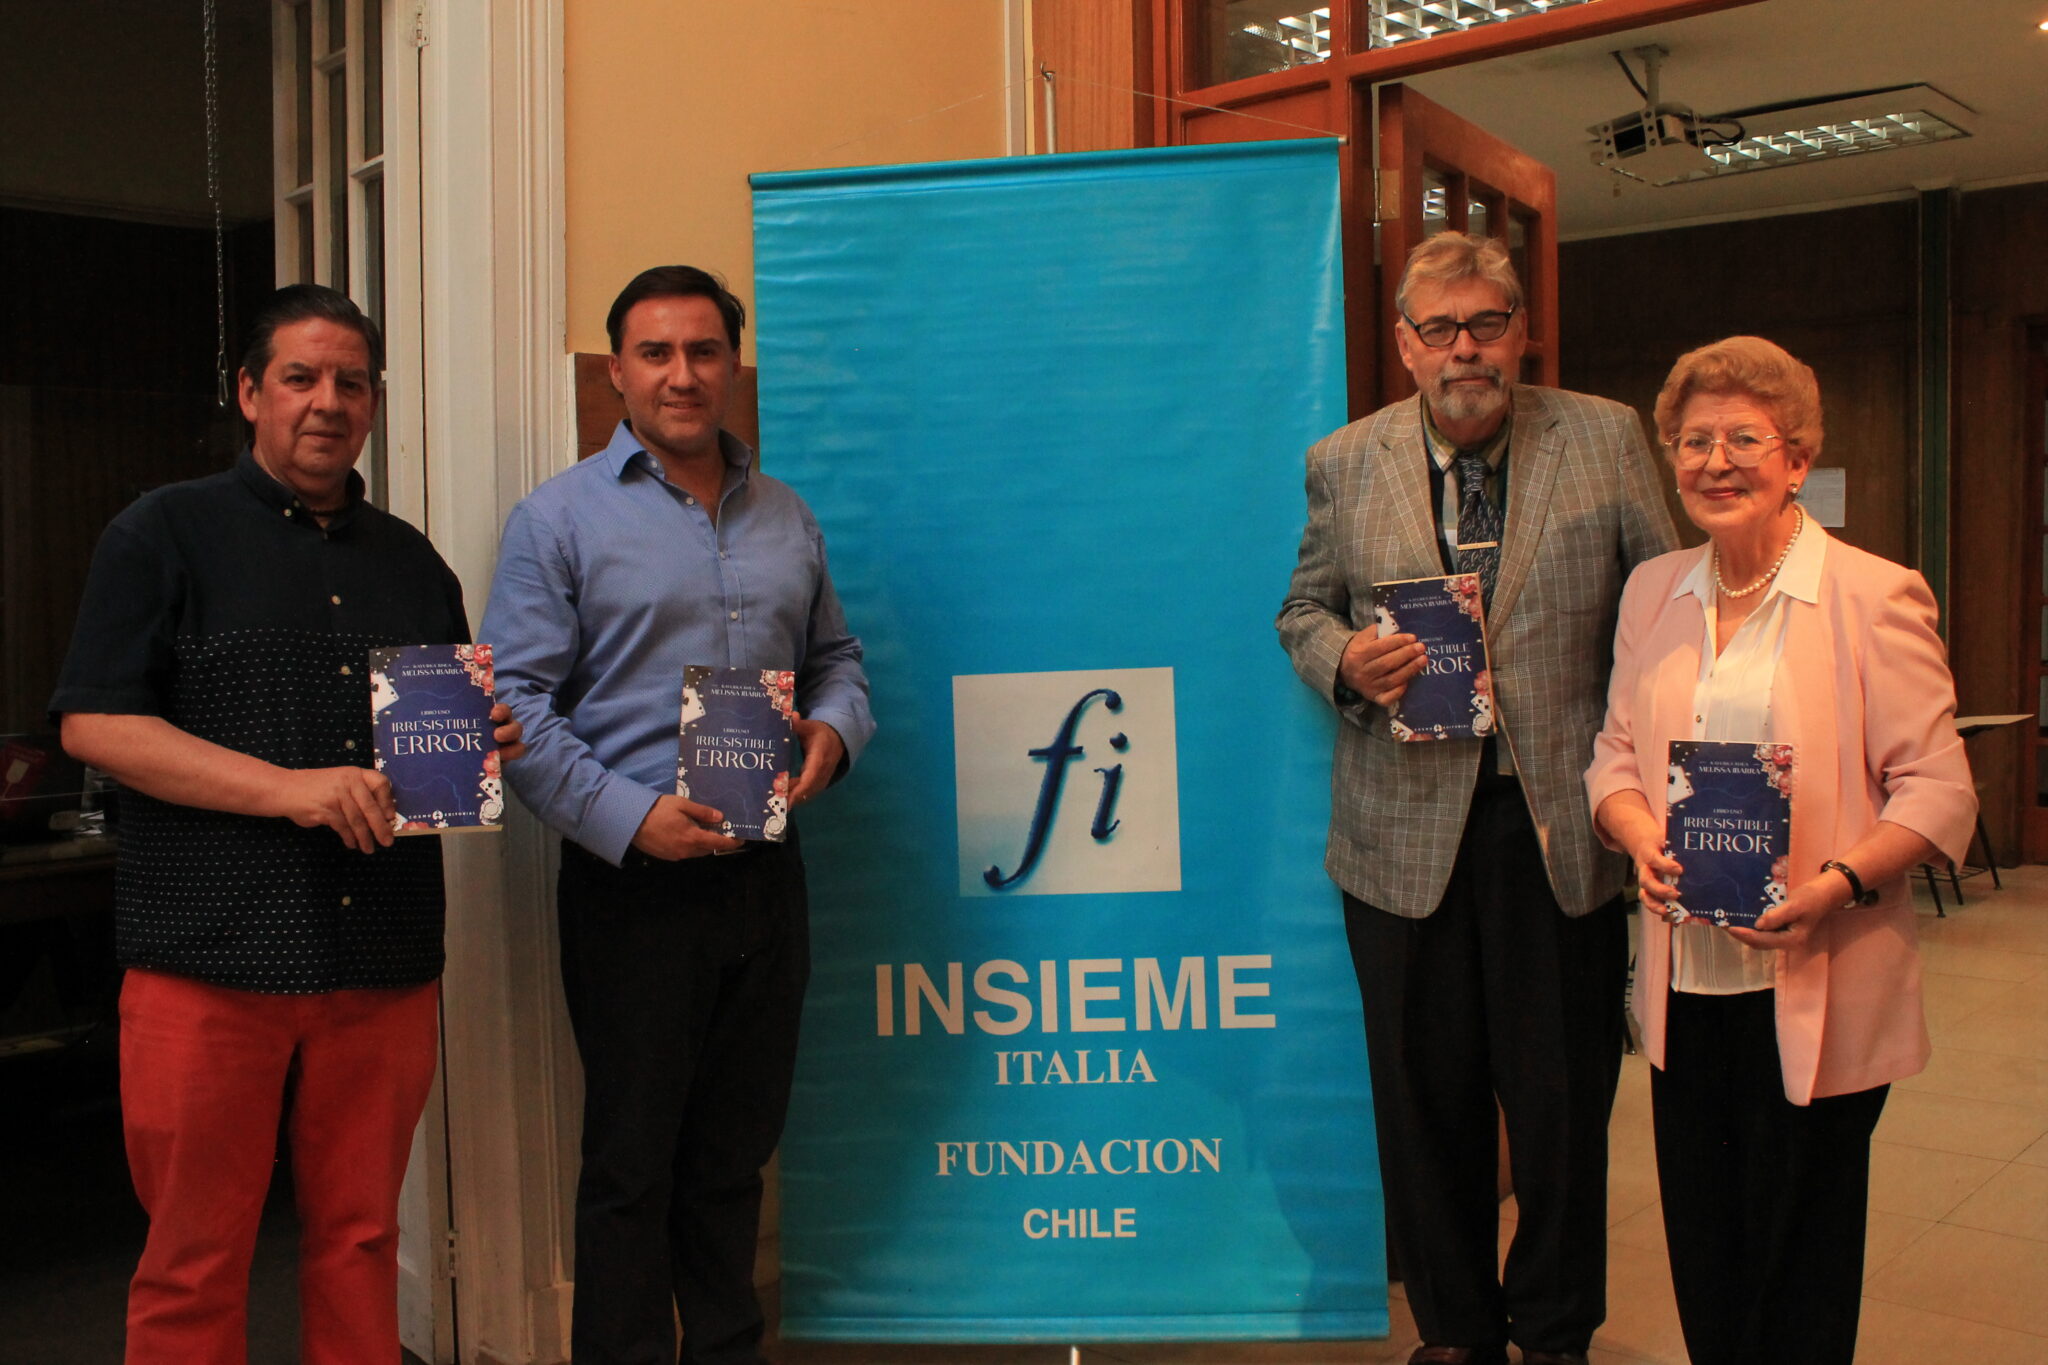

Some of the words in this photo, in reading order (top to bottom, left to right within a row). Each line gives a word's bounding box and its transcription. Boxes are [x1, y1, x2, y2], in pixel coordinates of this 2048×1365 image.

[1425, 643, 1471, 656] ISTIBLE
[401, 669, 436, 677] MELISSA
[436, 668, 464, 676] IBARRA
[1420, 655, 1472, 675] ROR
[711, 688, 740, 697] MELISSA
[392, 718, 482, 733] IRRESISTIBLE
[393, 732, 483, 756] ERROR
[696, 736, 776, 750] IRRESISTIBLE
[696, 749, 775, 771] ERROR
[1698, 766, 1731, 774] MELISSA
[983, 688, 1129, 889] fi
[1683, 816, 1773, 832] IRRESISTIBLE
[1684, 831, 1772, 854] ERROR
[875, 954, 1277, 1037] INSIEME
[994, 1049, 1158, 1086] ITALIA
[935, 1138, 1223, 1177] FUNDACION
[1022, 1207, 1138, 1238] CHILE
